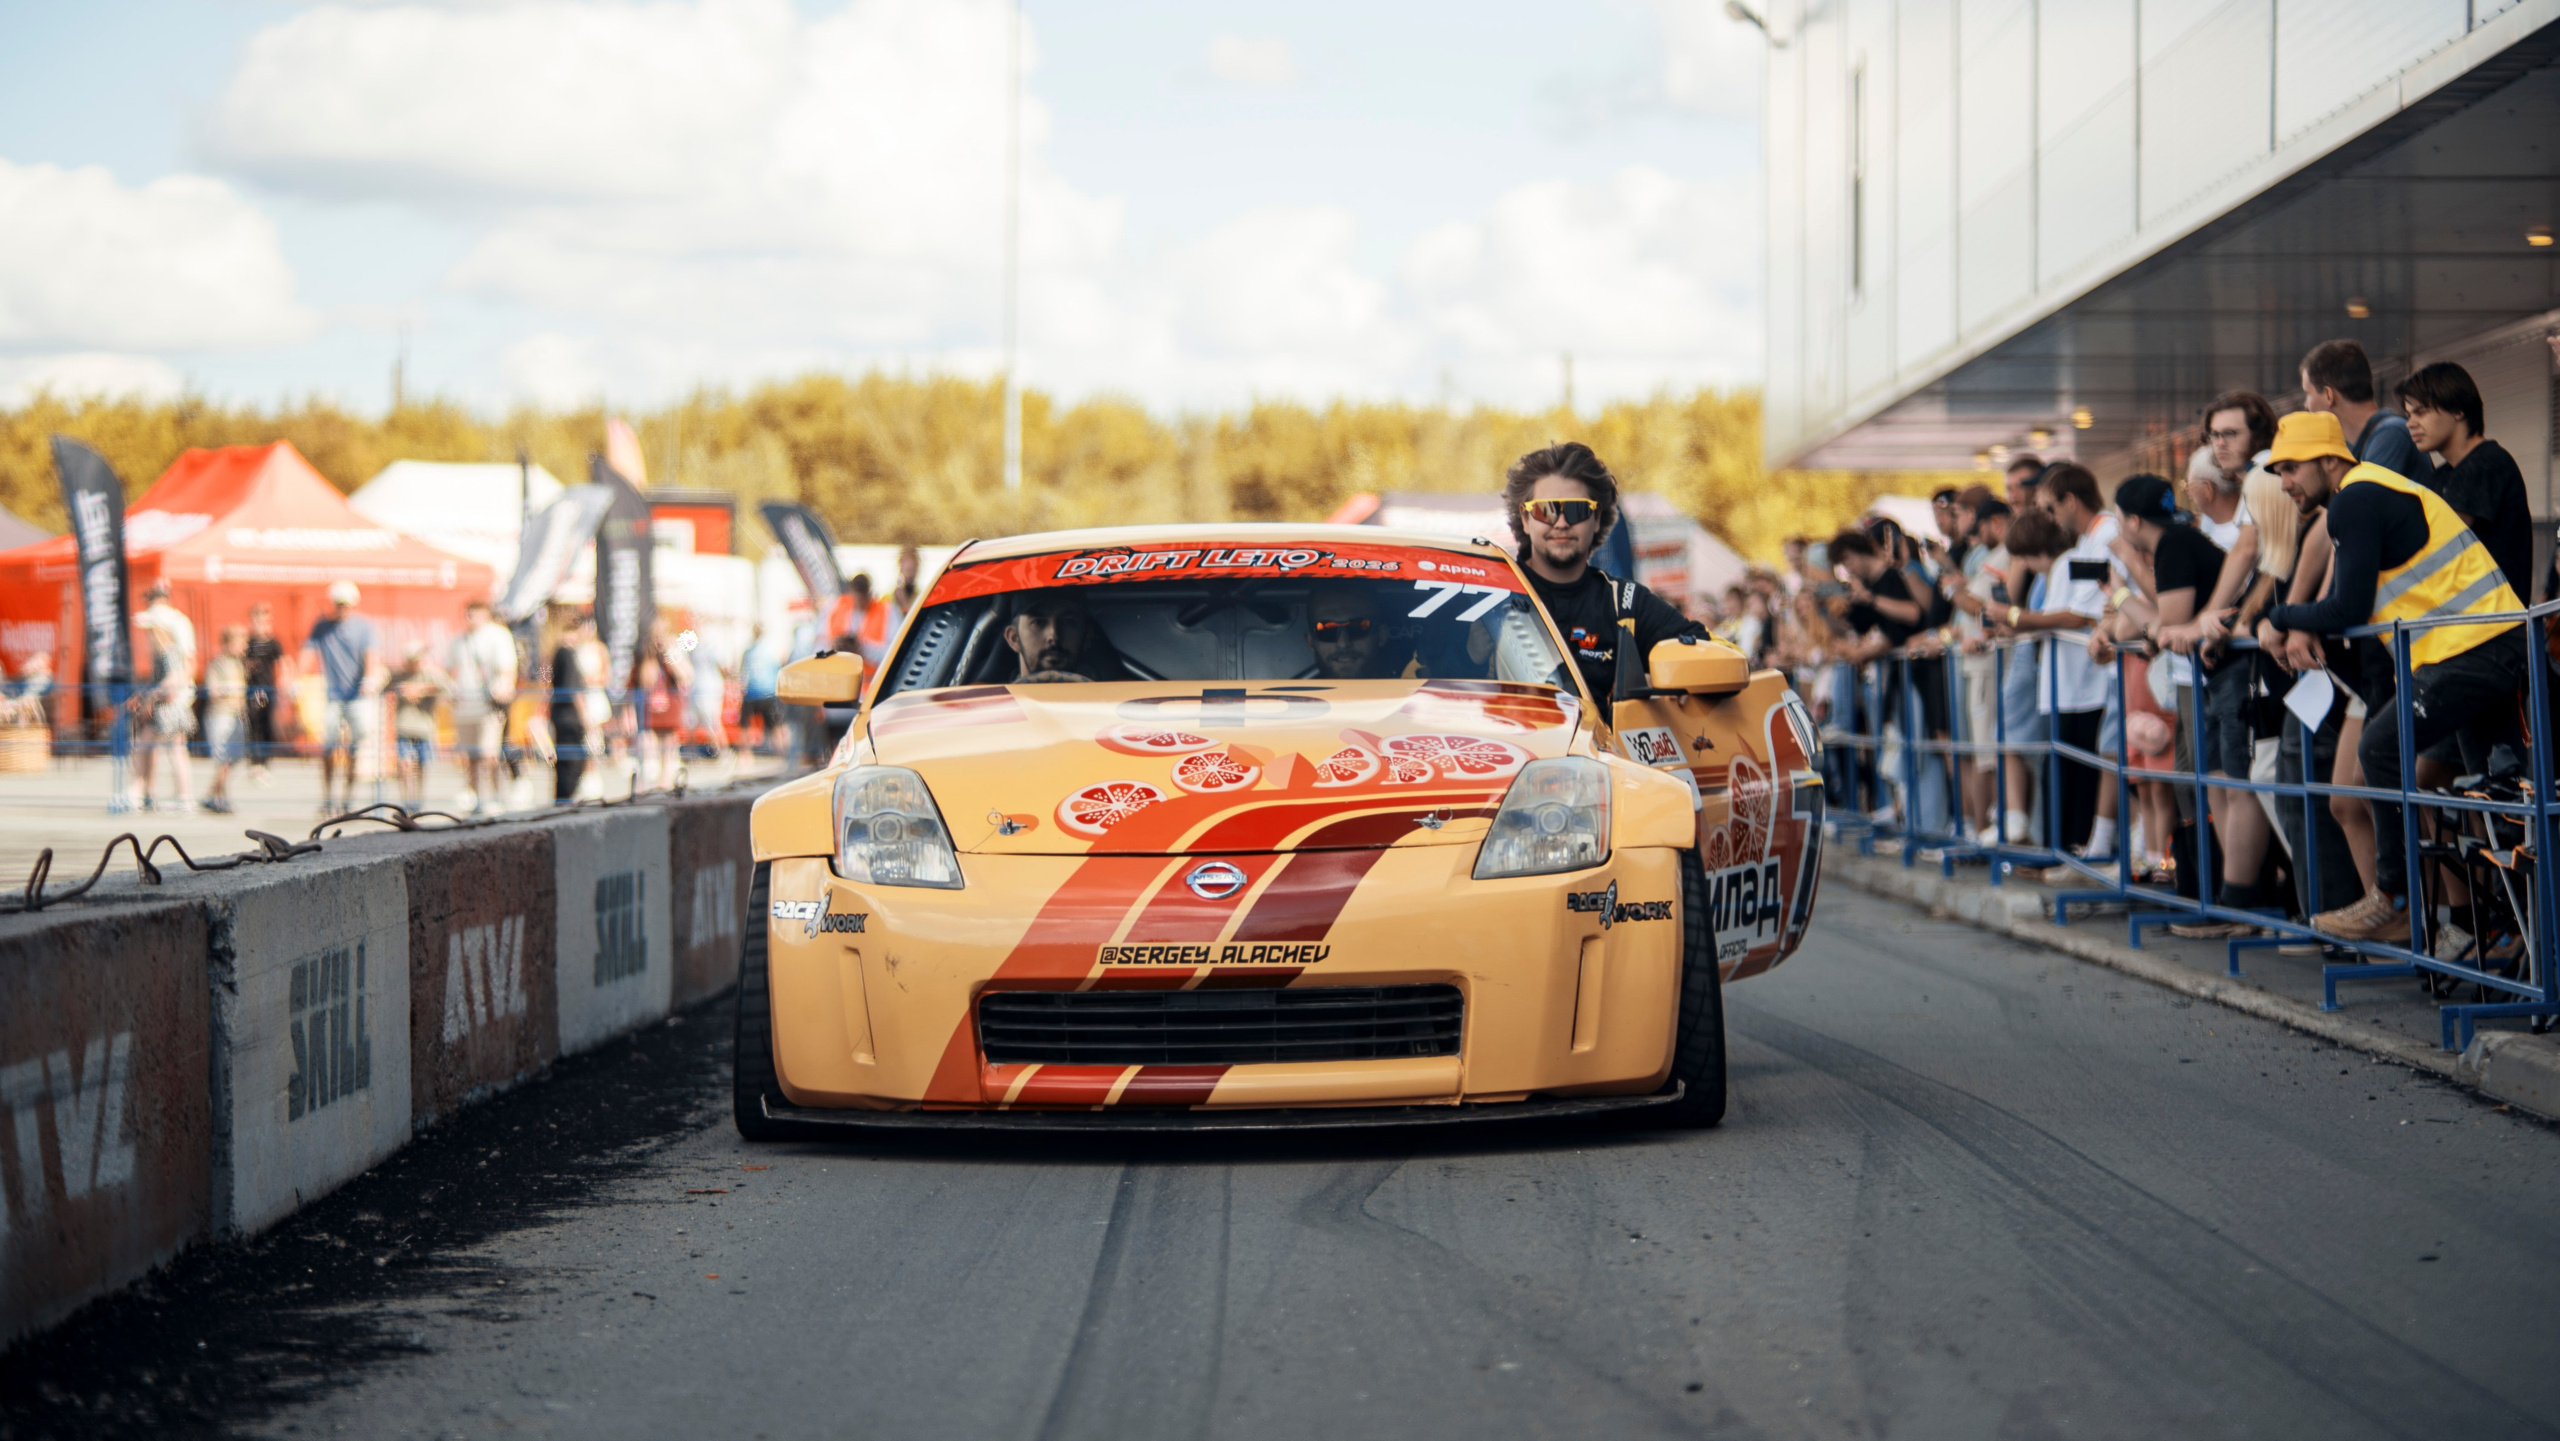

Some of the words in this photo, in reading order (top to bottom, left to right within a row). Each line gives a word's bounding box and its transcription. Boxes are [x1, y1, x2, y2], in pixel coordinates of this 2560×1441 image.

[1056, 550, 1201, 578] DRIFT
[1201, 548, 1319, 571] LETO
[1330, 557, 1399, 572] 2026
[1439, 563, 1486, 577] дром
[1408, 579, 1511, 623] 77
[1193, 874, 1240, 882] NISSAN
[772, 900, 820, 920] RACE
[820, 913, 869, 933] WORK
[1567, 892, 1608, 912] RACE
[1612, 900, 1674, 923] WORK
[1100, 945, 1331, 964] @SERGEY_ALACHEV
